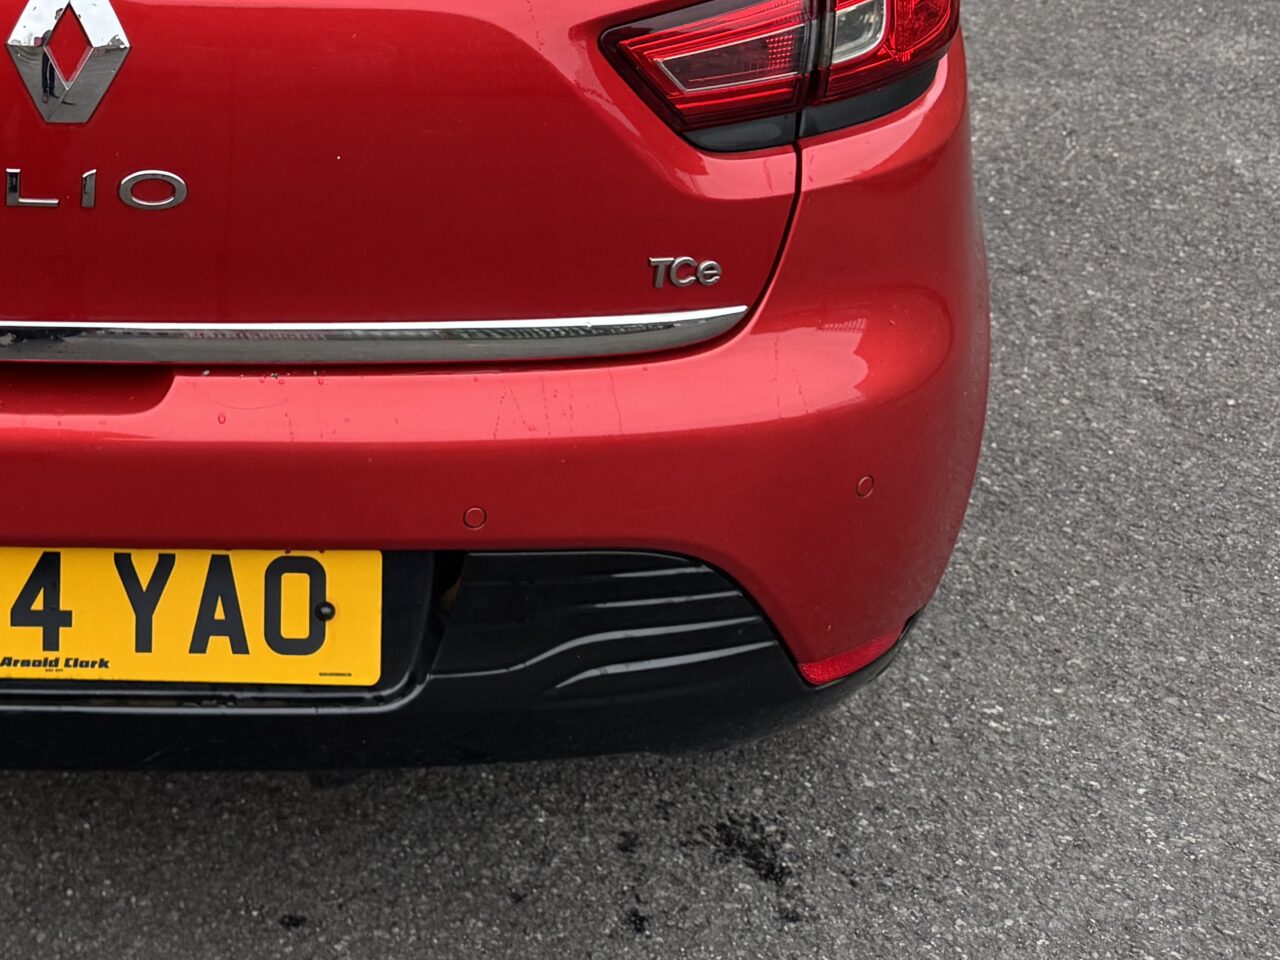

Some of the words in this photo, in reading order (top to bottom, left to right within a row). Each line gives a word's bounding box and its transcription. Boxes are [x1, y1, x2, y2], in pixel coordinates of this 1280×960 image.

[649, 256, 722, 289] TCe
[113, 552, 328, 657] YAO
[0, 656, 61, 668] Arnold
[63, 657, 110, 668] Clark
